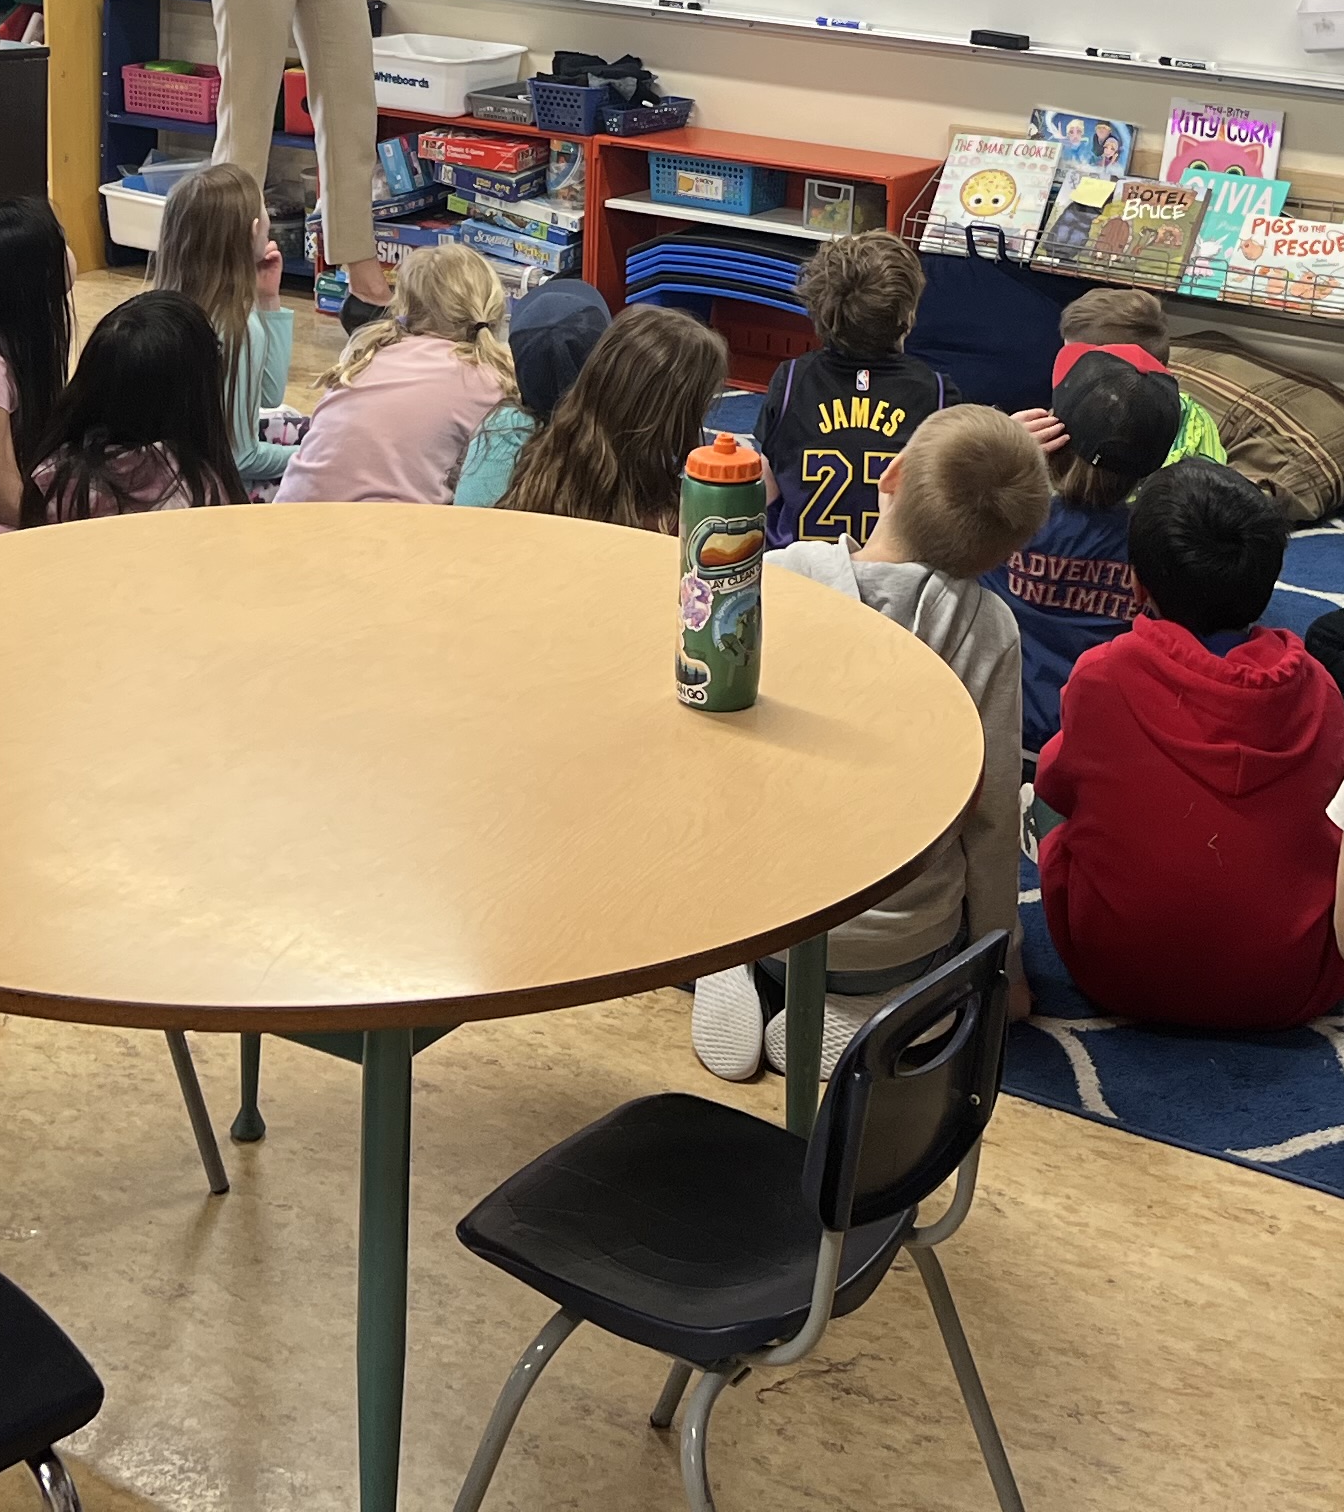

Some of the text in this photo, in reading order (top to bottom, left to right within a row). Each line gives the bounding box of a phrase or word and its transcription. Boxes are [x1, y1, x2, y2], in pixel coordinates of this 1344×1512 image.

[1227, 117, 1277, 149] CORN
[954, 138, 1057, 159] THE SMART COOKIE
[1126, 185, 1189, 206] HOTEL
[1250, 216, 1326, 238] PIGS TO THE
[817, 395, 906, 437] JAMES
[727, 567, 756, 587] CLEAN
[686, 689, 705, 702] GO
